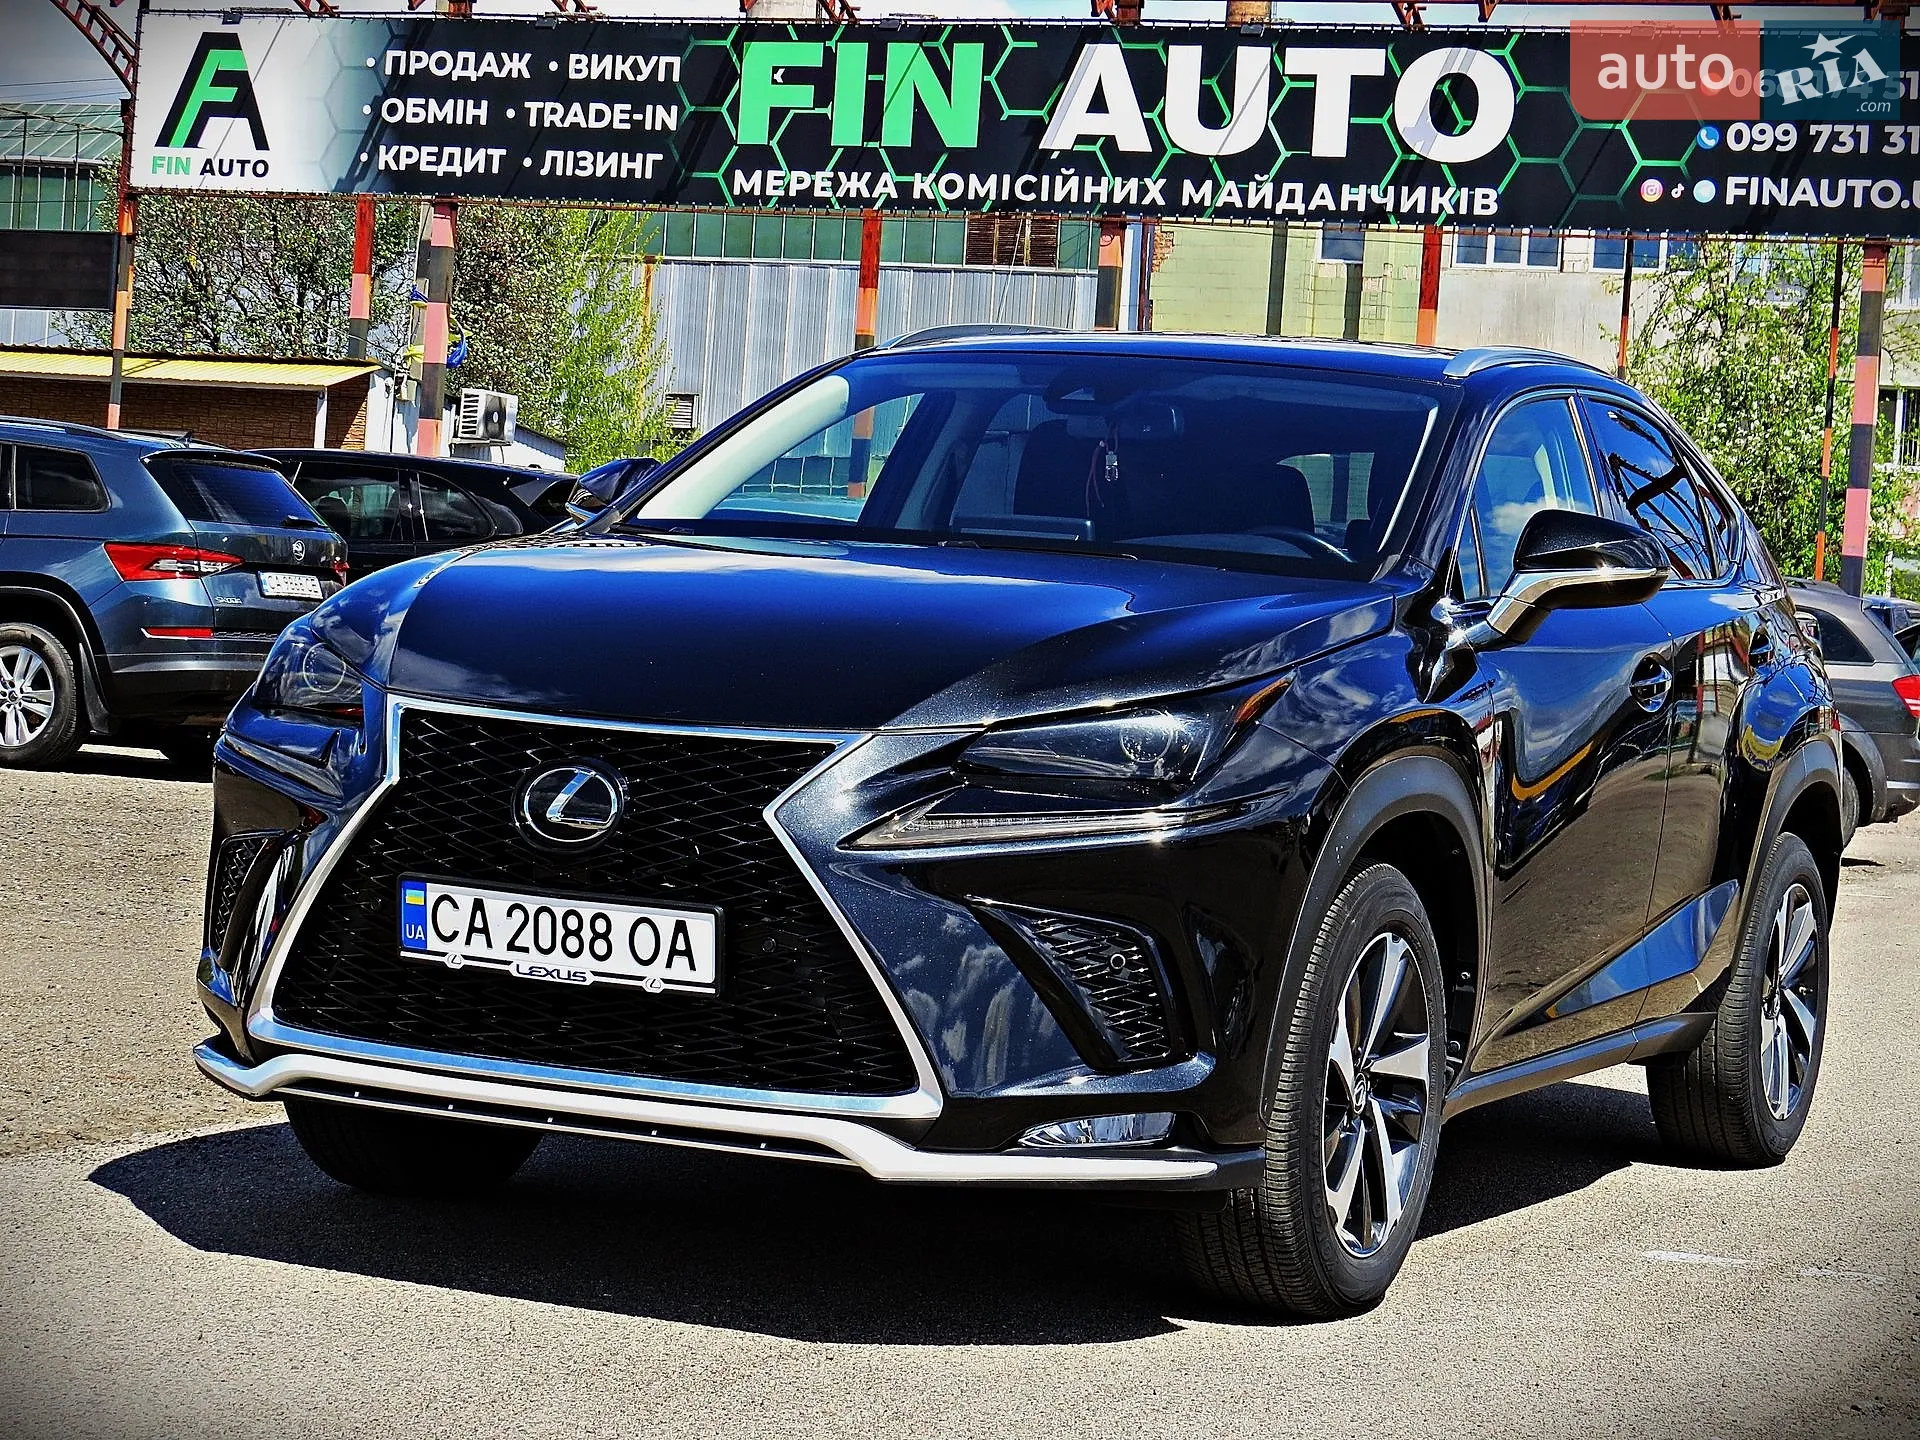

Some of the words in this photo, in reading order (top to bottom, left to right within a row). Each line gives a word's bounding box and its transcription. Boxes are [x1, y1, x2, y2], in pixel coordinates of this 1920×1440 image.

[385, 50, 531, 80] ПРОДАЖ
[569, 53, 681, 84] ВИКУП
[381, 97, 488, 126] ОБМІН
[524, 101, 679, 132] TRADE-IN
[735, 41, 984, 148] FIN
[1039, 42, 1516, 163] AUTO
[1726, 121, 1798, 152] 099
[1809, 124, 1870, 154] 731
[151, 156, 191, 176] FIN
[199, 158, 269, 178] AUTO
[377, 145, 507, 176] КРЕДИТ
[540, 151, 664, 181] ЛІЗИНГ
[732, 169, 898, 200] МЕРЕЖА
[913, 166, 1164, 207] КОМІСІЙНИХ
[1180, 172, 1499, 217] МАЙДАНЧИКІВ
[406, 923, 425, 941] UA
[431, 893, 493, 949] CA
[506, 903, 612, 962] 2088
[628, 916, 697, 972] OA
[515, 963, 587, 983] LEXUS
